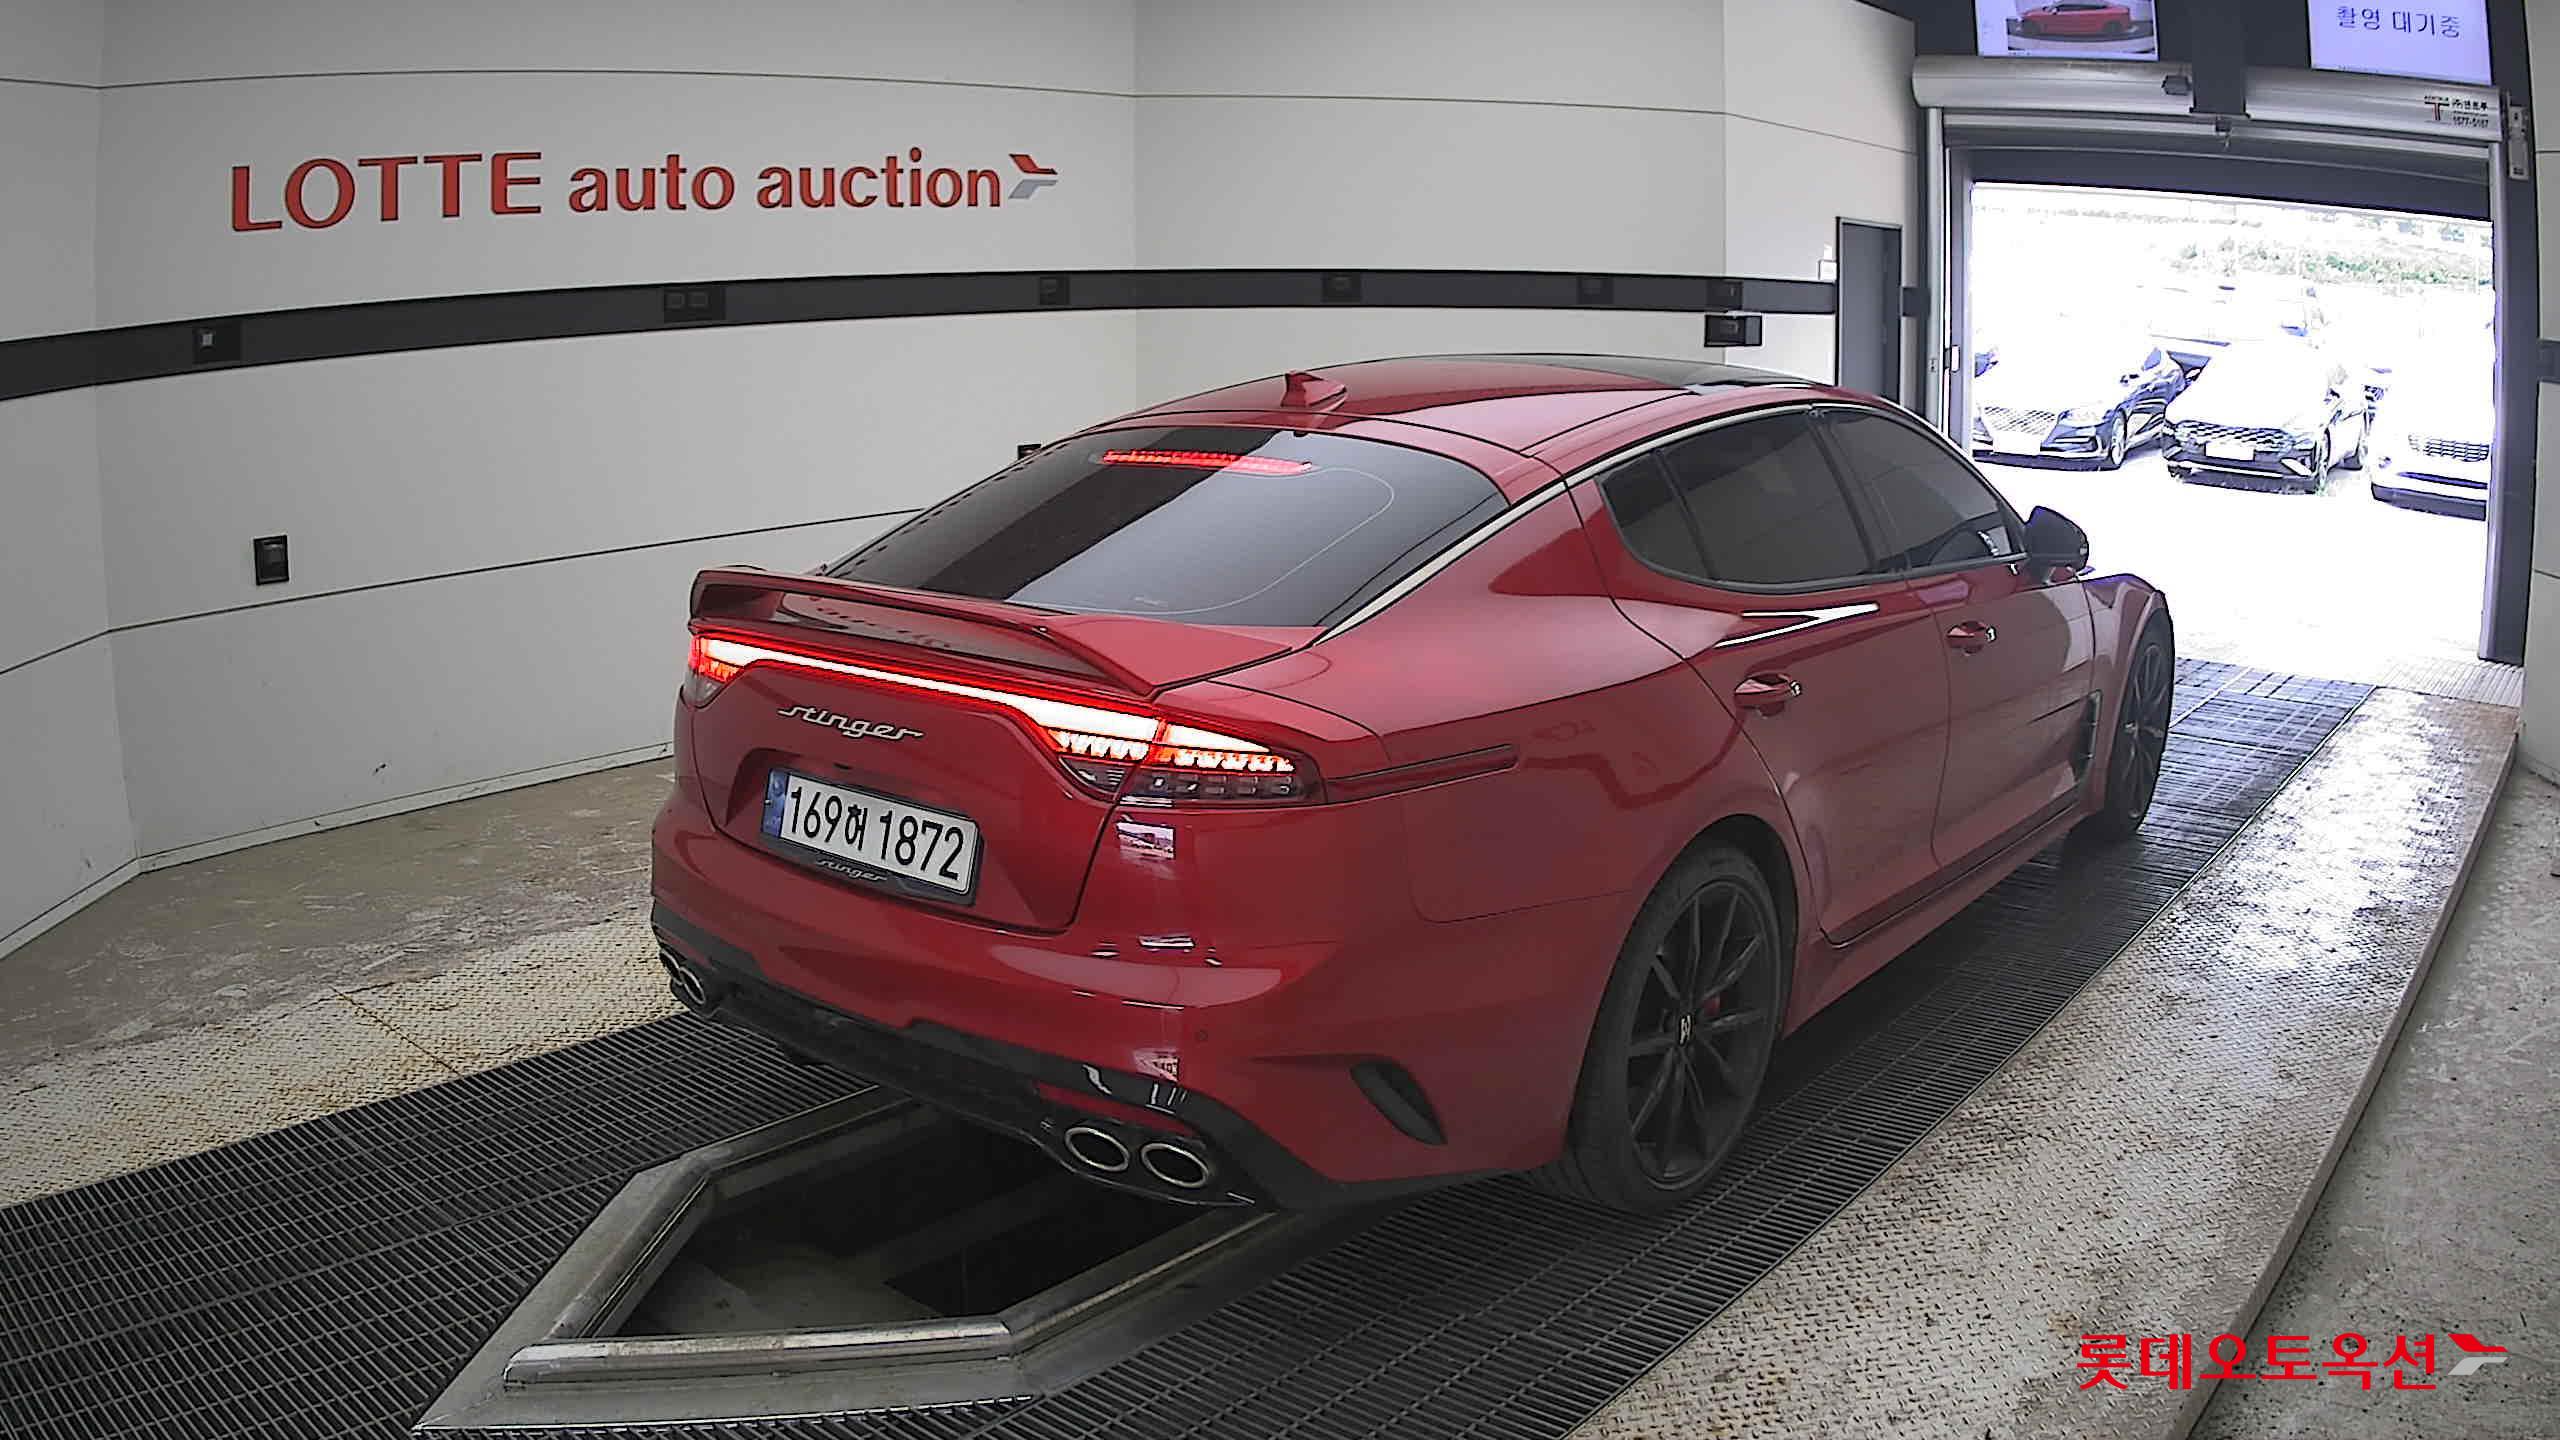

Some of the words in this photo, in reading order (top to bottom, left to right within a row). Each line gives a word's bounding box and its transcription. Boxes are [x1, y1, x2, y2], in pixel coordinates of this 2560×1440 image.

[2337, 6, 2381, 31] 촬영
[2392, 11, 2461, 39] 대기중
[231, 151, 542, 232] LOTTE
[568, 153, 736, 212] auto
[756, 146, 1002, 209] auction
[790, 786, 868, 851] 169허
[880, 809, 965, 881] 1872
